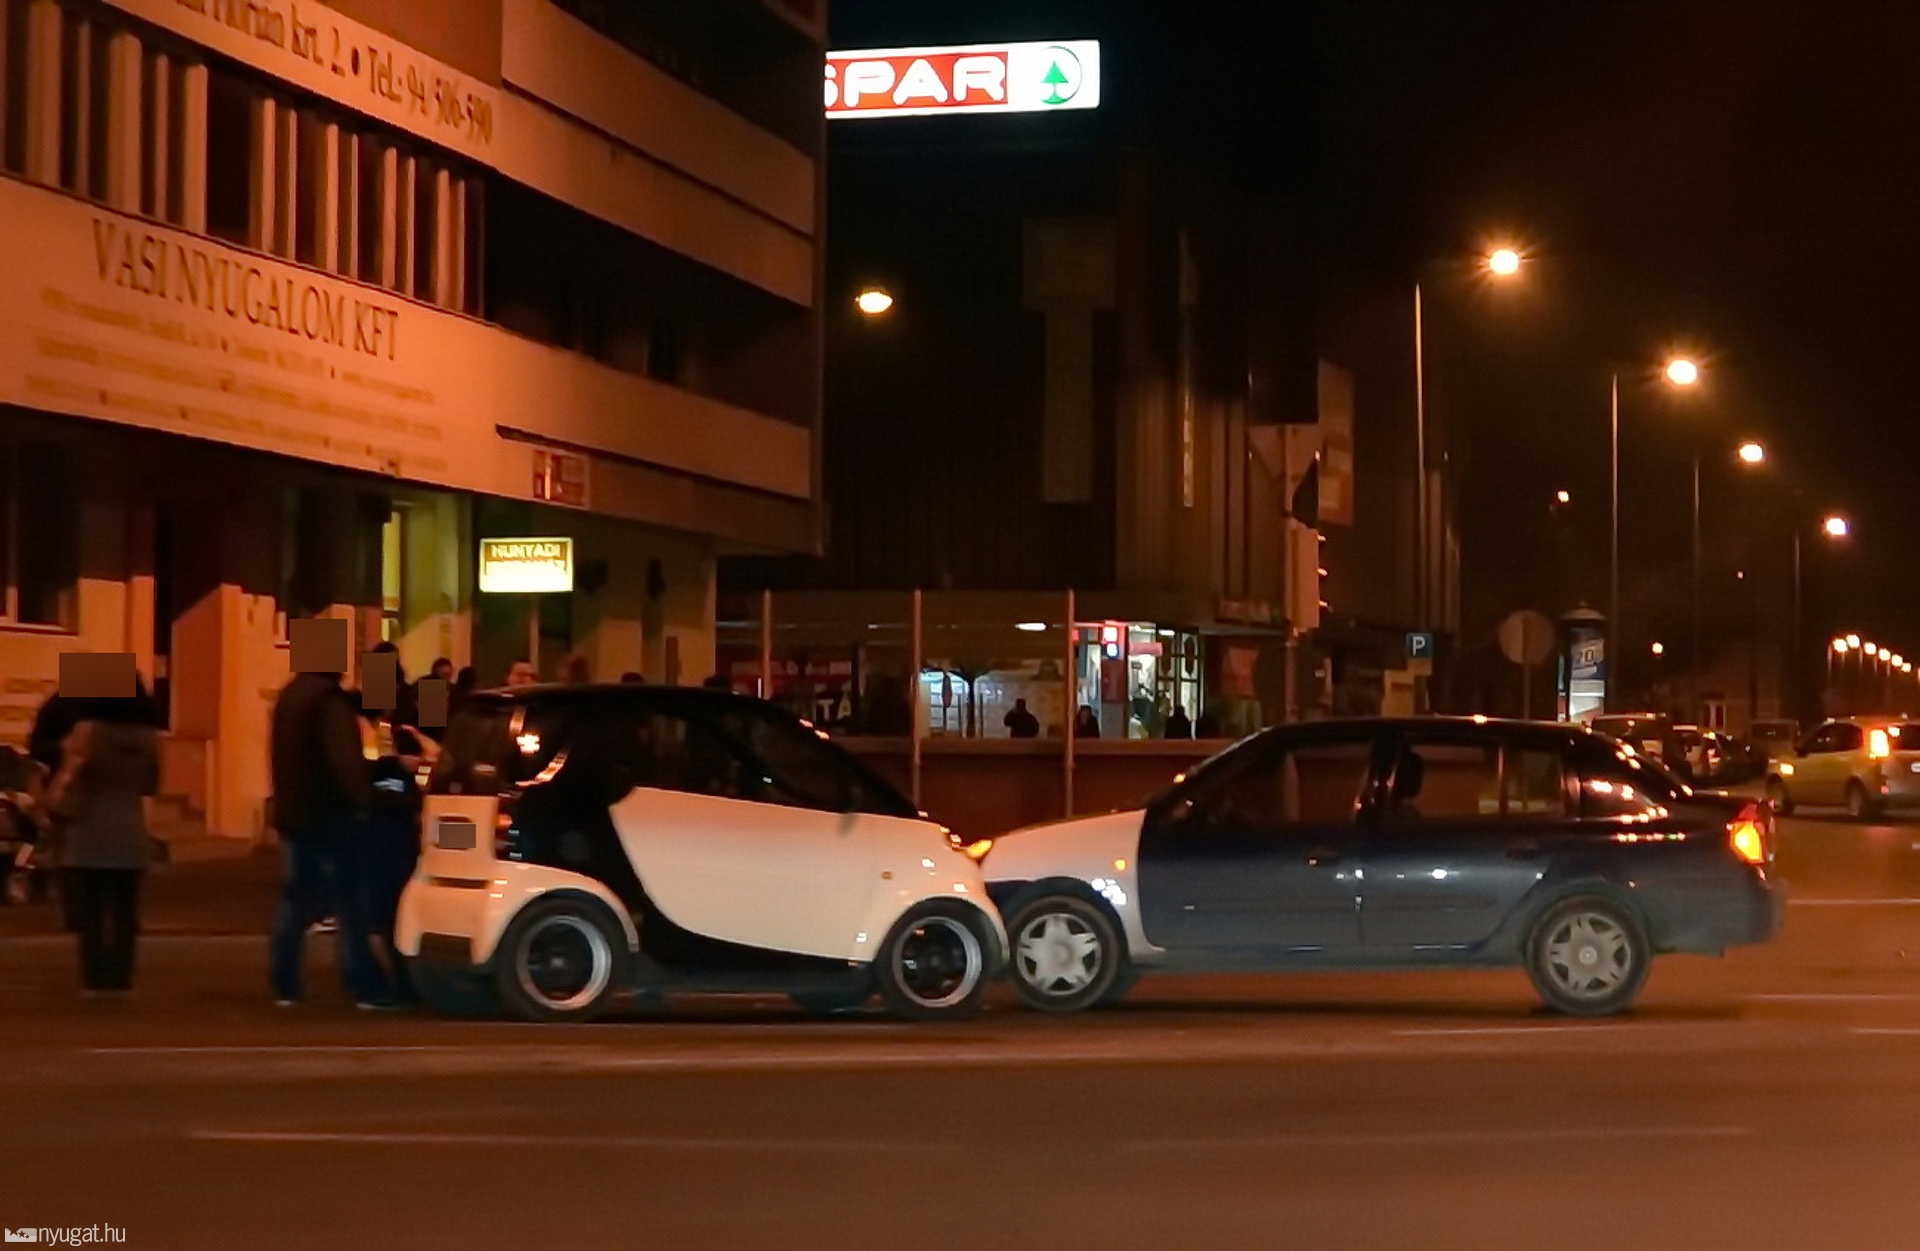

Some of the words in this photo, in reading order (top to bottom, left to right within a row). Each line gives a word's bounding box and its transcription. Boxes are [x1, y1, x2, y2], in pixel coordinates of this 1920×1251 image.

[93, 217, 167, 291] VASI
[175, 243, 345, 349] NYUGALOM
[354, 298, 399, 361] KFT
[1412, 635, 1426, 657] P
